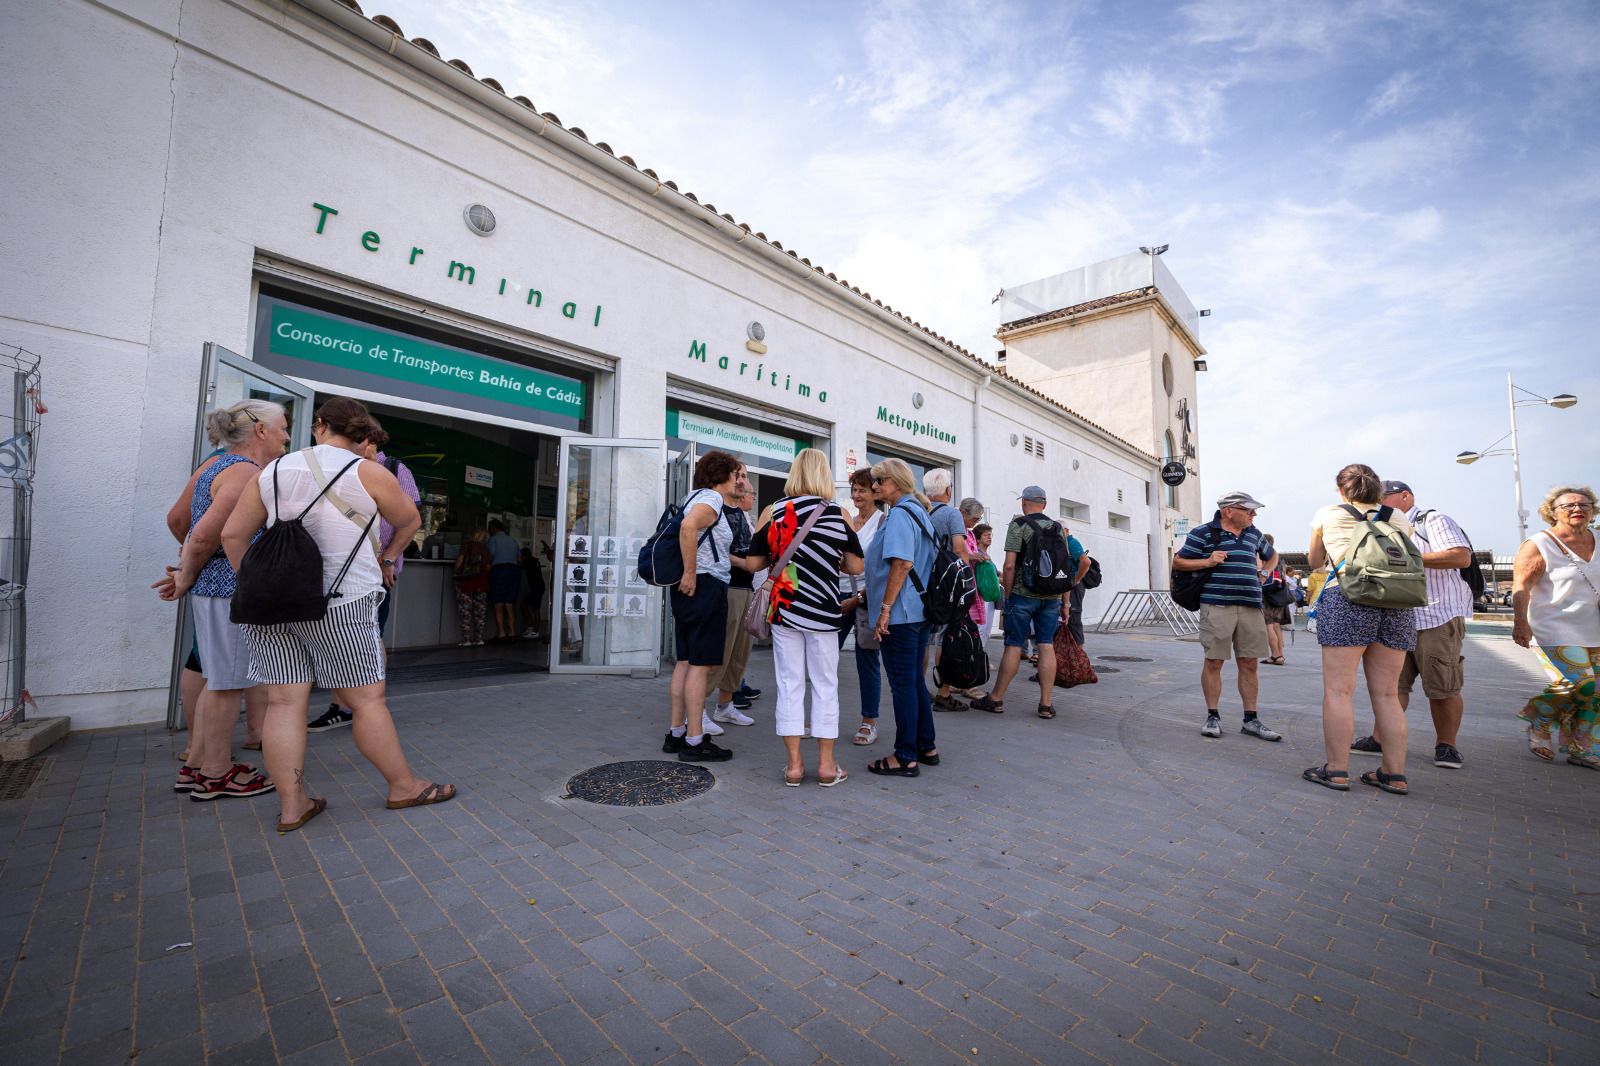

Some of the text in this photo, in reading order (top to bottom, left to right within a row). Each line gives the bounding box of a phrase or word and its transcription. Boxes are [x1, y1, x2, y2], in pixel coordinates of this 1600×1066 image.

[313, 202, 602, 327] Terminal
[276, 322, 582, 406] Consorcio de Transportes Bahía de Cádiz
[688, 339, 827, 403] Marítima
[682, 418, 715, 436] Terminal
[750, 436, 793, 454] Metropolitana
[877, 405, 957, 445] Metropolitana
